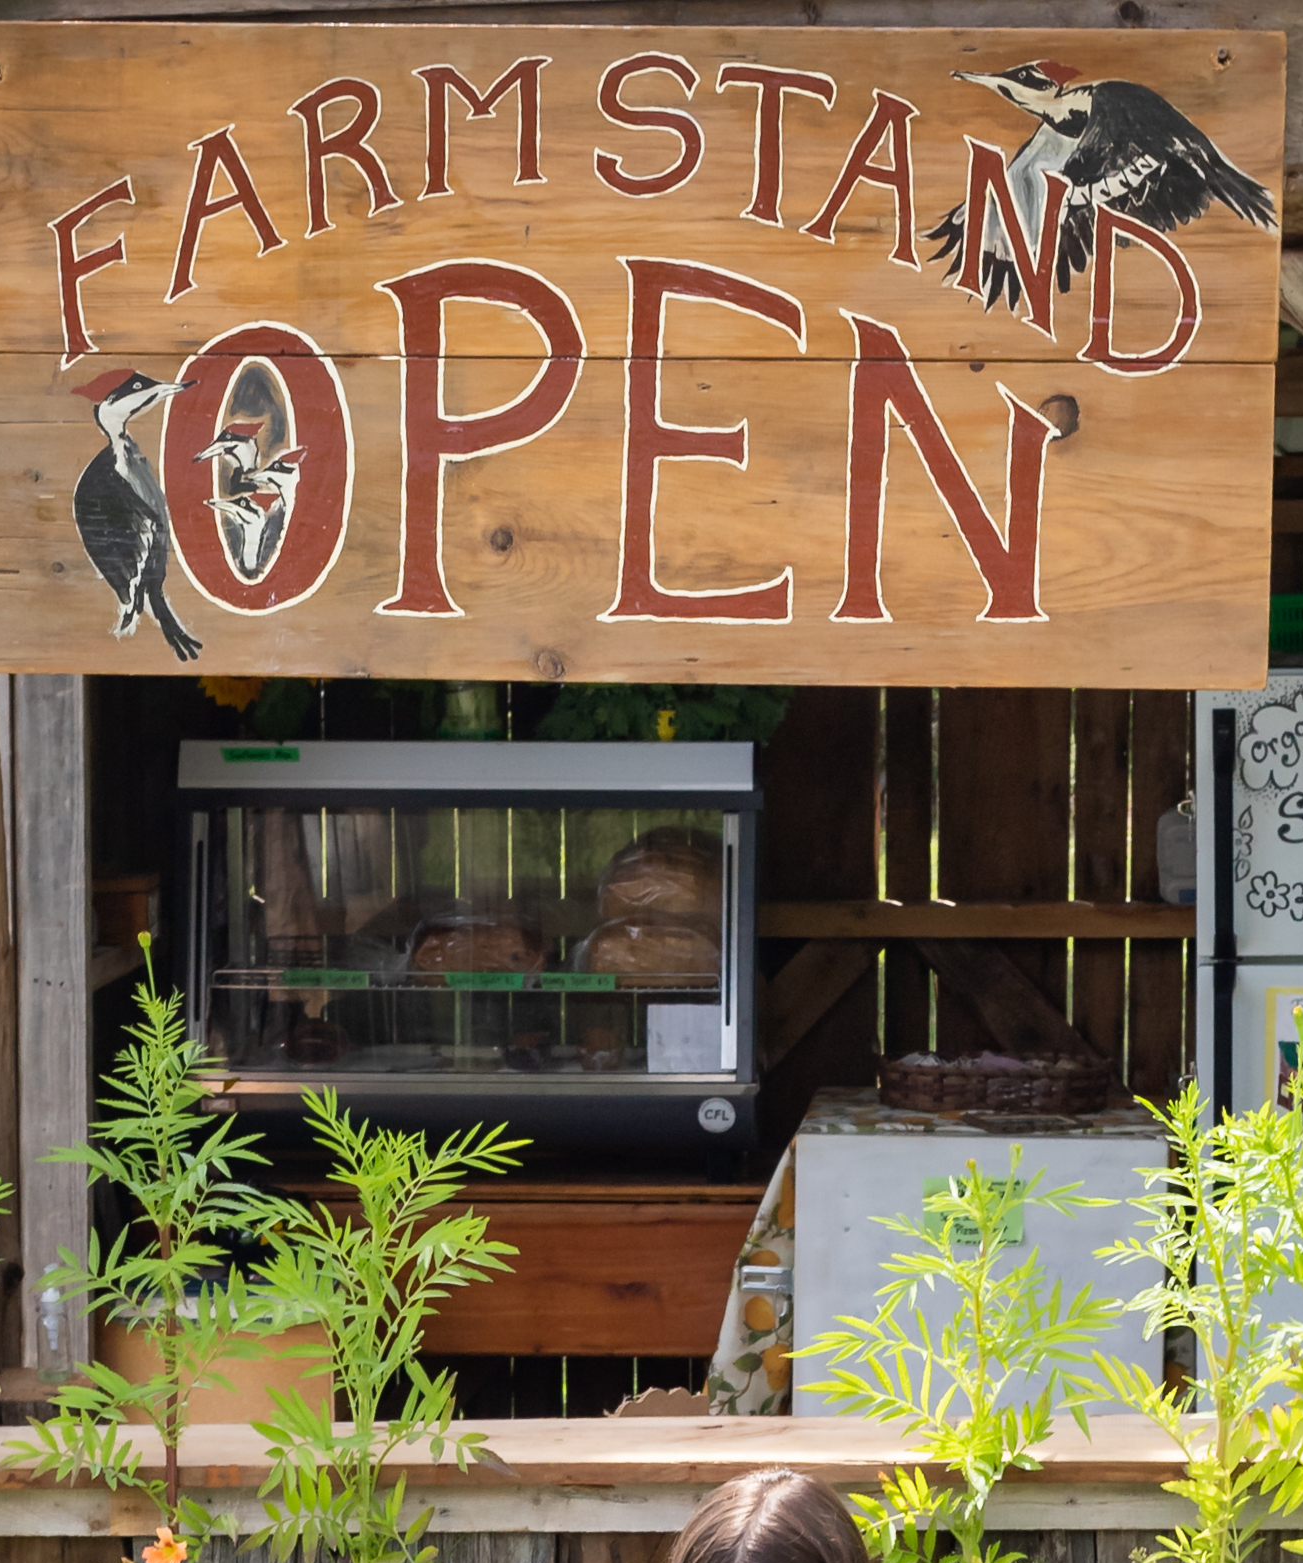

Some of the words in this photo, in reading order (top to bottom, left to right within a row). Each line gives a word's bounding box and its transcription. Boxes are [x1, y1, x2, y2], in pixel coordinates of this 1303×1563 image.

[48, 50, 1202, 376] FARMSTAND
[160, 255, 1061, 624] OPEN
[703, 1108, 730, 1122] CFL
